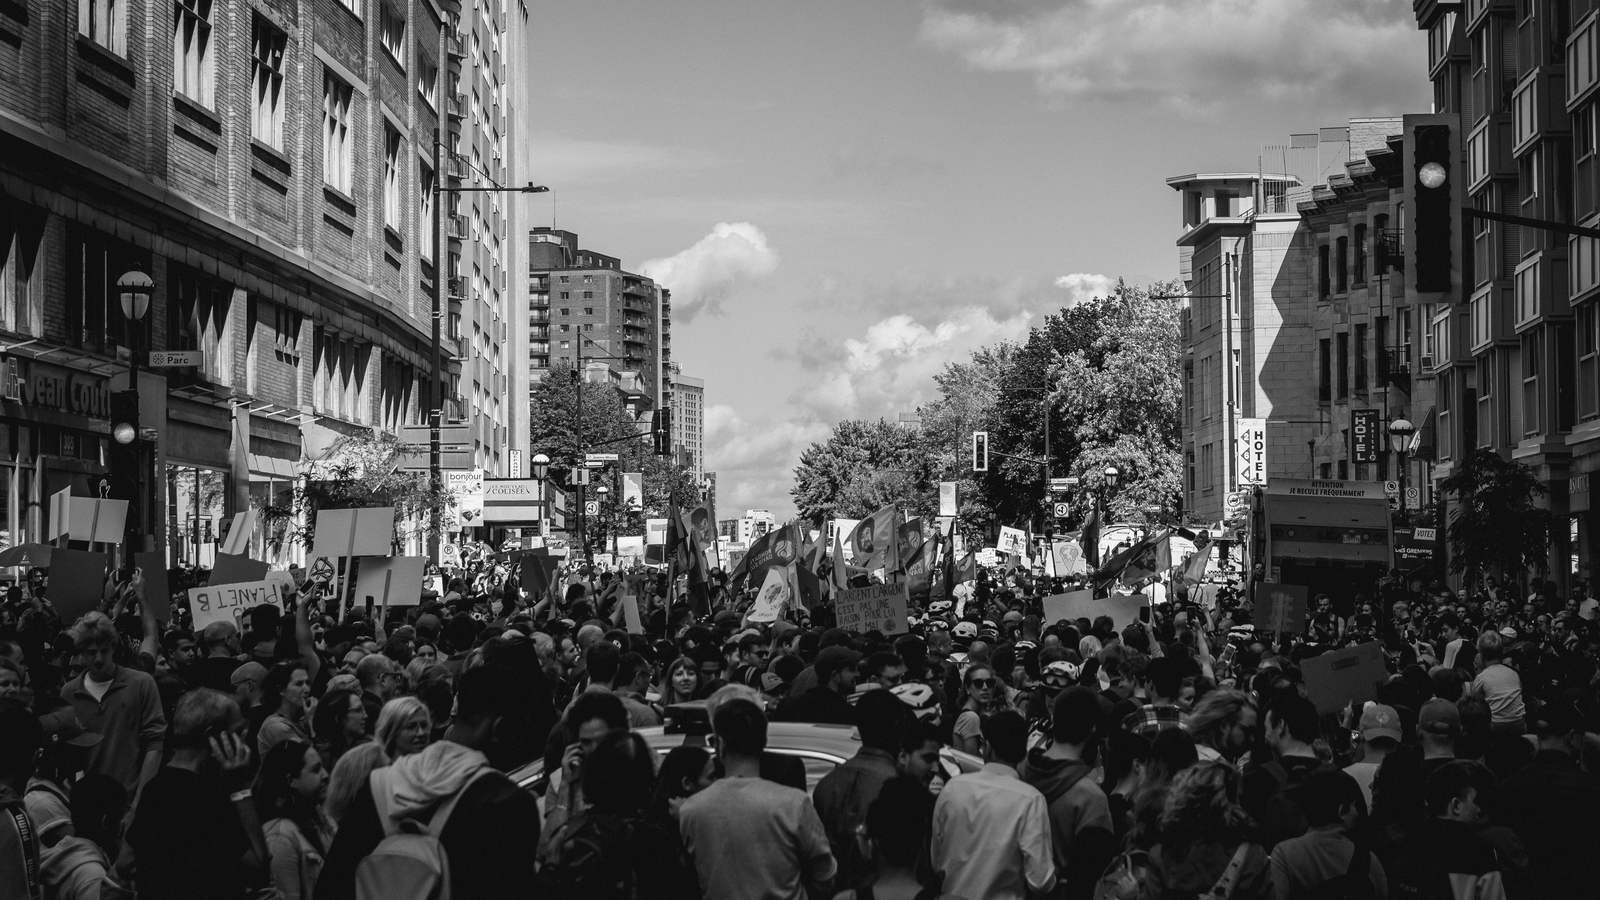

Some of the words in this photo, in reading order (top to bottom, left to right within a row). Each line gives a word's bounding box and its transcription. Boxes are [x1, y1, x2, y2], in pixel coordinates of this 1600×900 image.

[24, 362, 67, 408] Jean
[1354, 417, 1366, 461] HÔTEL
[1254, 431, 1263, 482] HOTEL
[450, 472, 482, 481] bonjour
[1311, 481, 1344, 489] ATTENTION
[1319, 488, 1365, 497] FRÉQUEMMENT
[1417, 530, 1434, 538] VOTEZ
[196, 593, 211, 612] B
[217, 584, 279, 609] PLANET
[836, 588, 871, 604] L'ARGENT
[872, 583, 905, 598] L'ARGENT
[859, 601, 872, 612] PAS
[876, 598, 890, 609] UNE
[839, 613, 860, 625] RAISON
[864, 609, 882, 620] POUR
[884, 607, 896, 618] LUI
[15, 813, 30, 842] PUMA
[27, 858, 36, 887] PUMA
